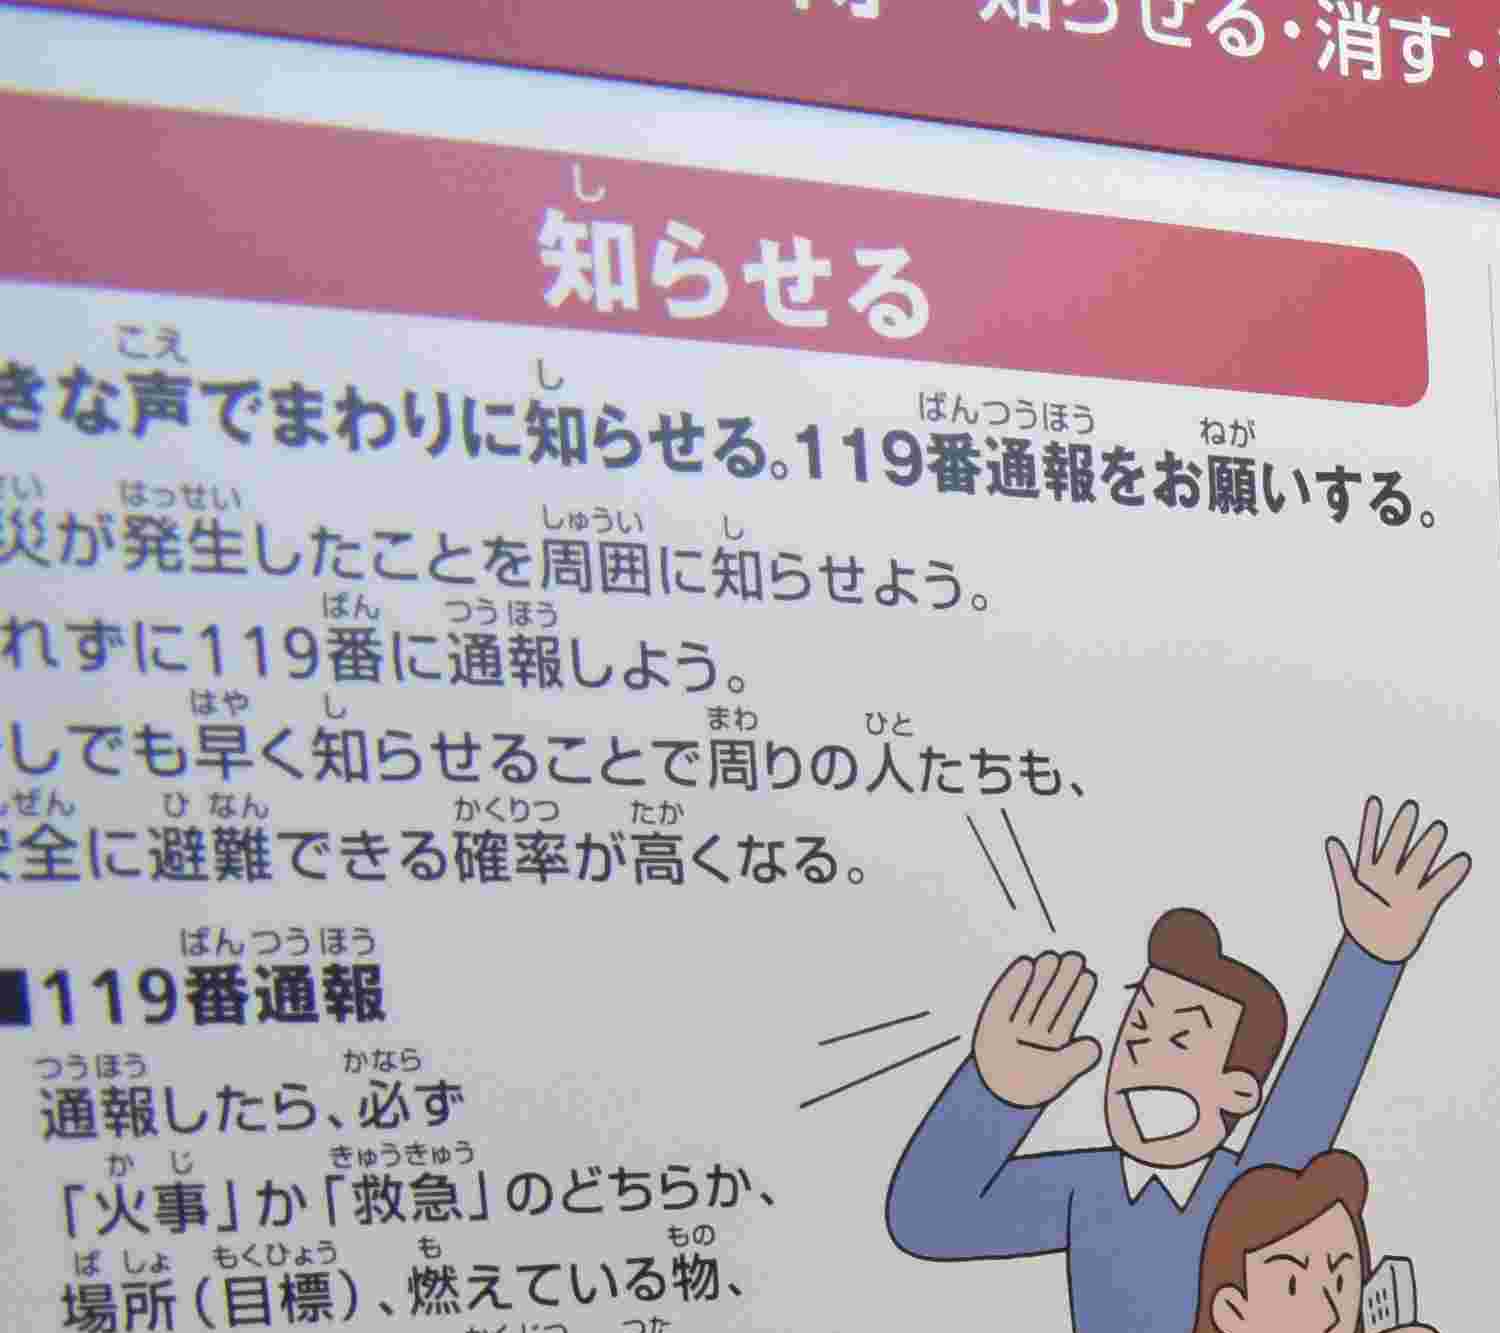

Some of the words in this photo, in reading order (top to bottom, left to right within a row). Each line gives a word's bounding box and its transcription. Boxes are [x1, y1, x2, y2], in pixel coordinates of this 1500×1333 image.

[537, 207, 931, 340] 知らせる
[116, 325, 188, 364] こえ
[918, 390, 1095, 436] ばんつうほう
[1201, 416, 1256, 449] ねが
[120, 480, 242, 513] はっせい
[541, 503, 645, 536] しゅうい
[321, 591, 380, 621] ばん
[445, 601, 560, 629] つうほう
[0, 614, 745, 695] れずに119番に通報しよう。
[190, 688, 250, 717] はや
[707, 705, 759, 732] まわ
[865, 711, 914, 738] ひと
[0, 720, 1087, 799] しでも早く知らせることで周りの人たちも、
[454, 795, 561, 825] かくりつ
[629, 799, 684, 826] たか
[0, 823, 866, 886] 全に避難できる確率が高くなる。
[180, 925, 376, 957] ばんつうほう
[39, 961, 387, 1027] 119番通報
[34, 1052, 147, 1080] つうほう
[342, 1047, 423, 1073] かなら
[39, 1076, 466, 1142] 通報したら、必ず
[329, 1141, 477, 1168] きゅうきゅう
[62, 1162, 778, 1237] 「火事」か「救急」のどちらか、
[212, 1239, 339, 1270] もくひょう
[667, 1222, 716, 1246] もの
